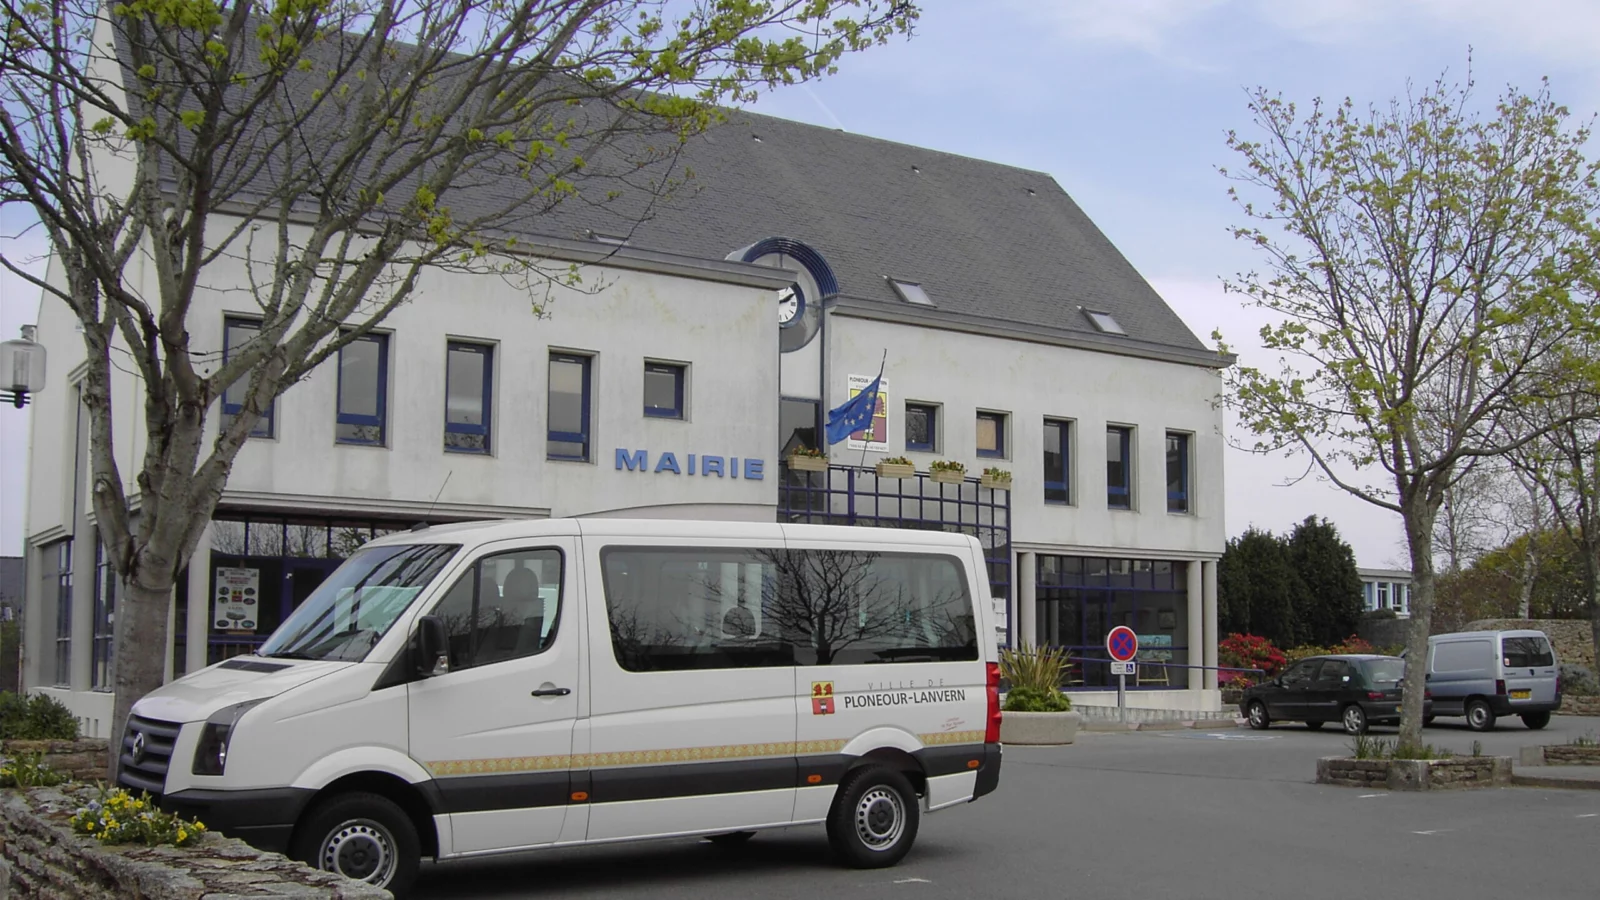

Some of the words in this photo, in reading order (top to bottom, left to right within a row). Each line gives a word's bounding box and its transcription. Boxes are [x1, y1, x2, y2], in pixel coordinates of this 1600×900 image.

[615, 448, 765, 480] MAIRIE
[868, 680, 914, 690] VILLE
[928, 678, 944, 687] DE
[844, 689, 966, 708] PLONEOUR-LANVERN
